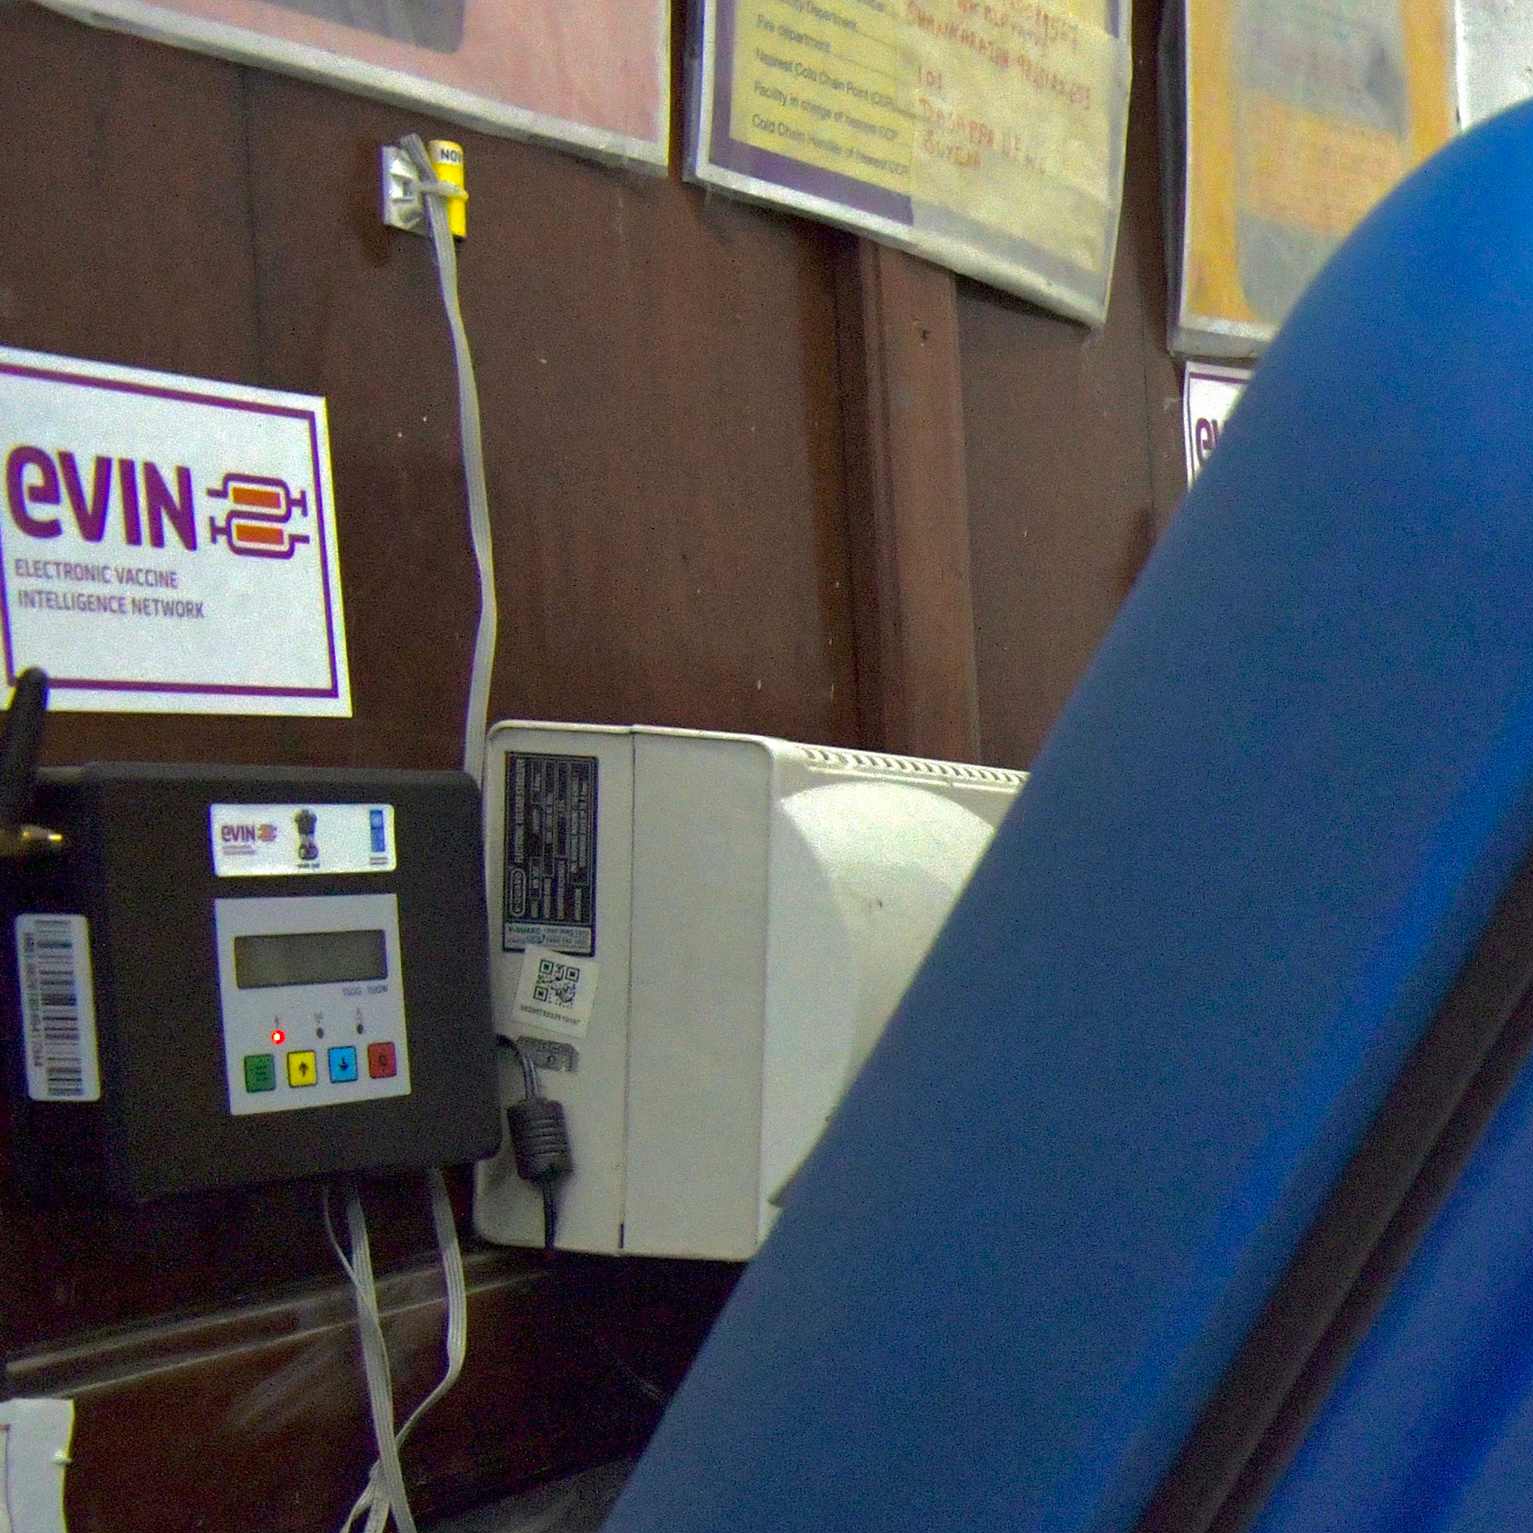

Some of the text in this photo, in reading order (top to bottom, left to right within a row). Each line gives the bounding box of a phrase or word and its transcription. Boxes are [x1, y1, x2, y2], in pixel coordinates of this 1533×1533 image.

[754, 79, 788, 106] Facility
[751, 113, 776, 134] Cold
[777, 122, 806, 143] Chain
[1195, 417, 1218, 465] e
[6, 445, 198, 552] eVIN
[15, 558, 179, 590] ELECTRONIC VACCINE
[18, 590, 206, 620] INTELLIGENCE NETWORK
[221, 824, 256, 843] eVIN
